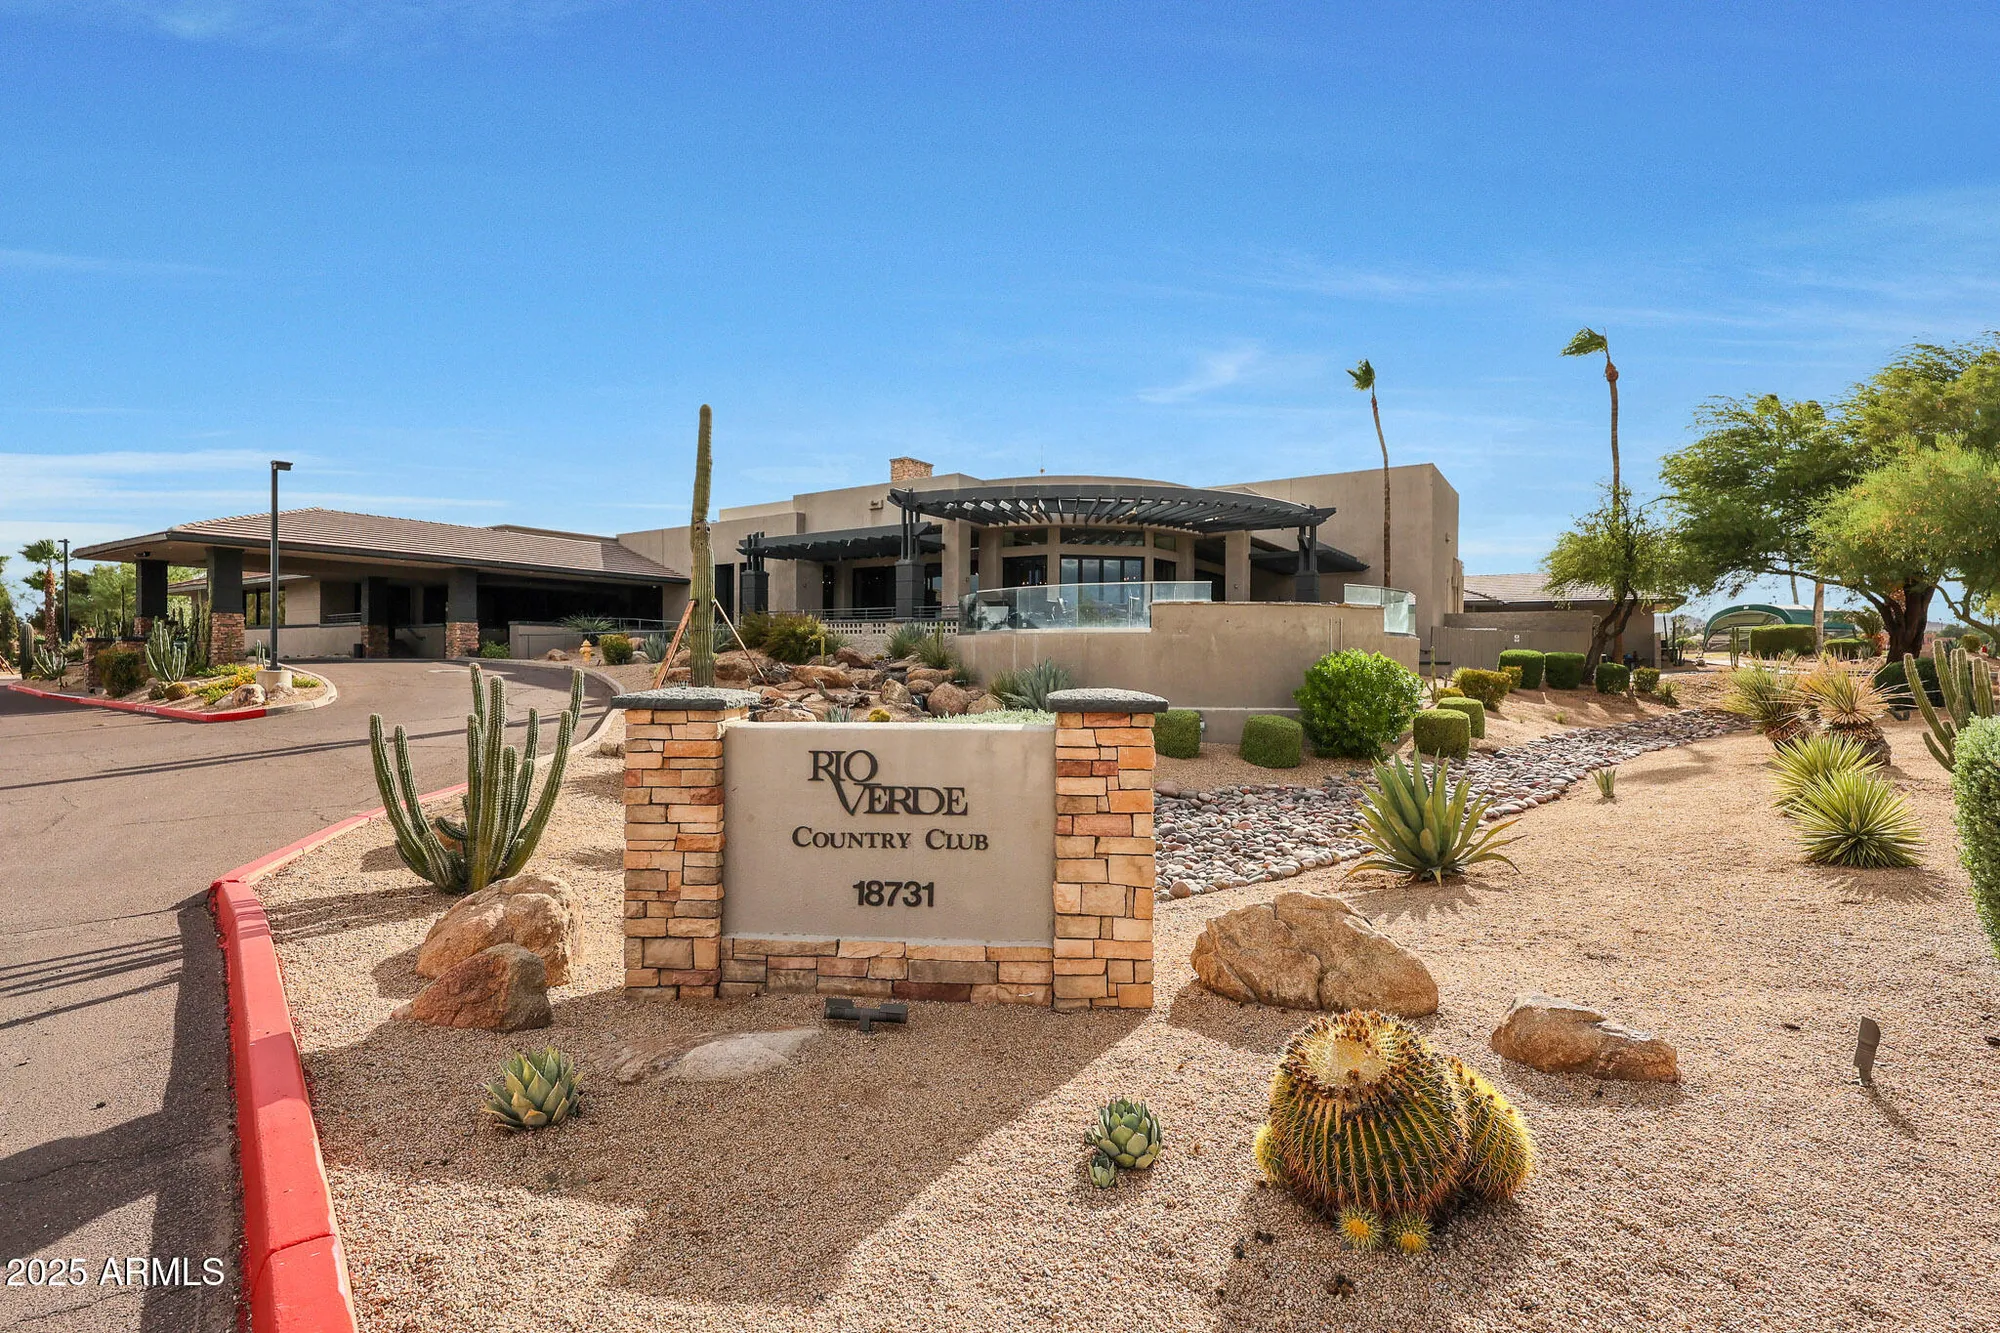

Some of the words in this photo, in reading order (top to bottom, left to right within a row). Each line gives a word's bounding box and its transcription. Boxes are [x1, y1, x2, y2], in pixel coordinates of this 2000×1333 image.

[807, 749, 879, 783] RIO
[834, 782, 969, 817] VERDE
[791, 825, 913, 850] COUNTRY
[925, 828, 989, 851] CLUB
[852, 880, 935, 908] 18731
